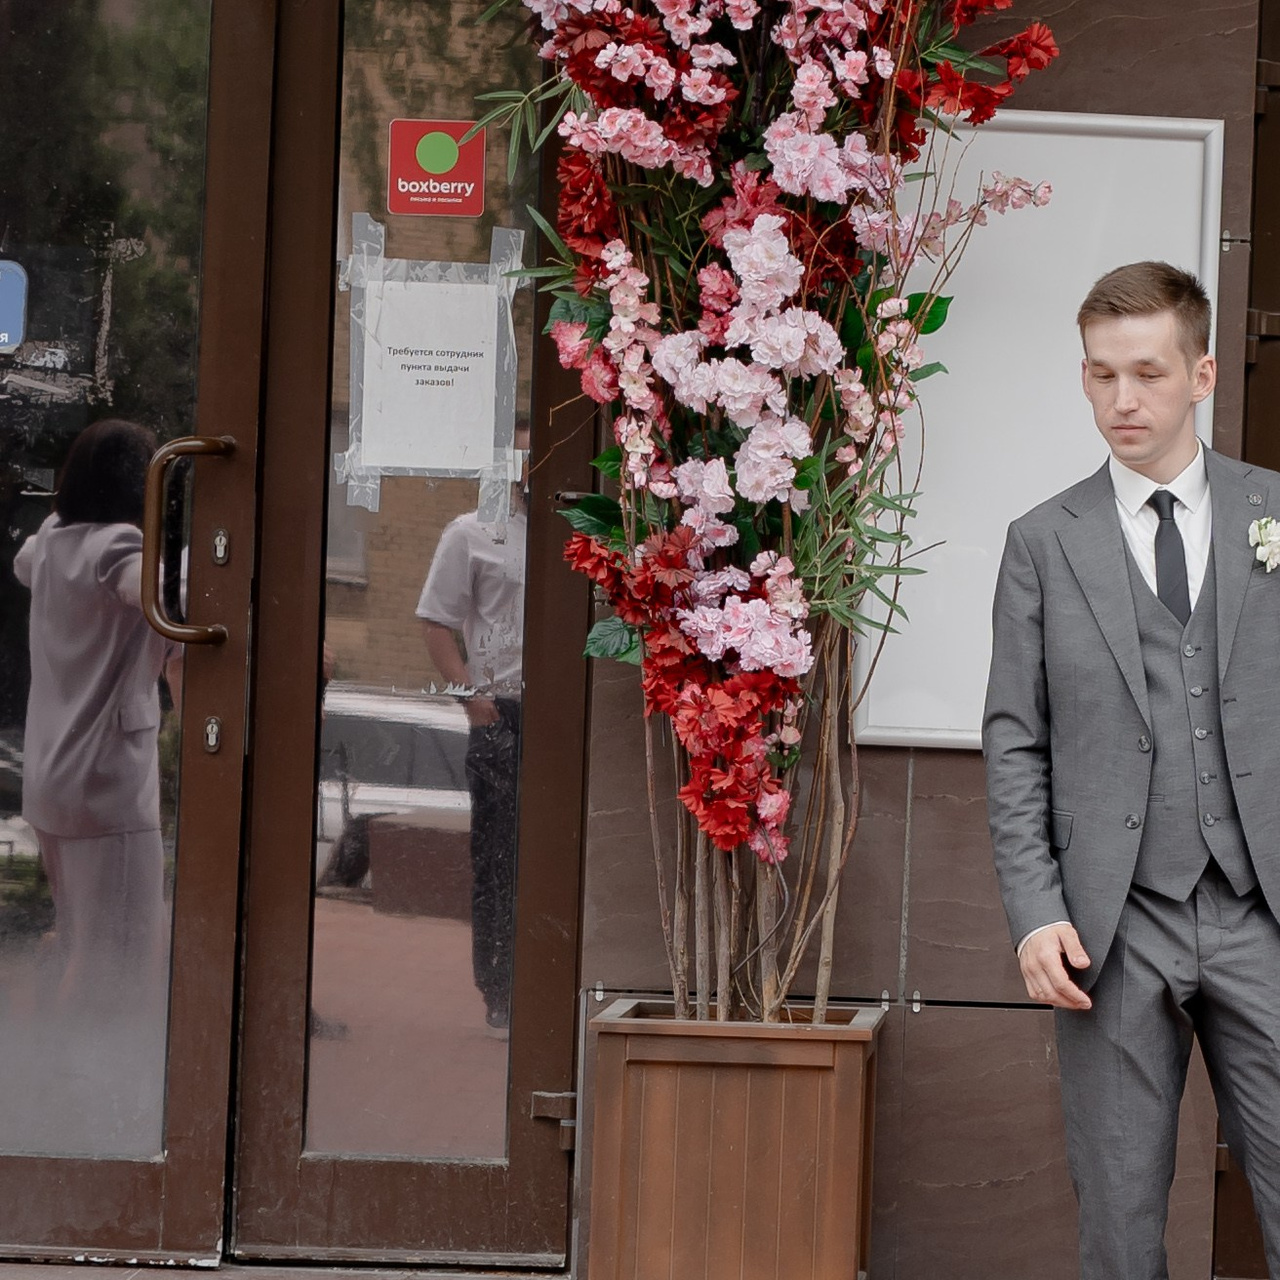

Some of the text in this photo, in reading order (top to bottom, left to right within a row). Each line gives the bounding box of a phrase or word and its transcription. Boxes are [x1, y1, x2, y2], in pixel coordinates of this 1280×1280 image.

[397, 177, 475, 197] boxberry
[387, 346, 484, 359] Требуется сотрудник
[400, 363, 470, 373] пункта выдачи
[414, 378, 455, 387] заказов!
